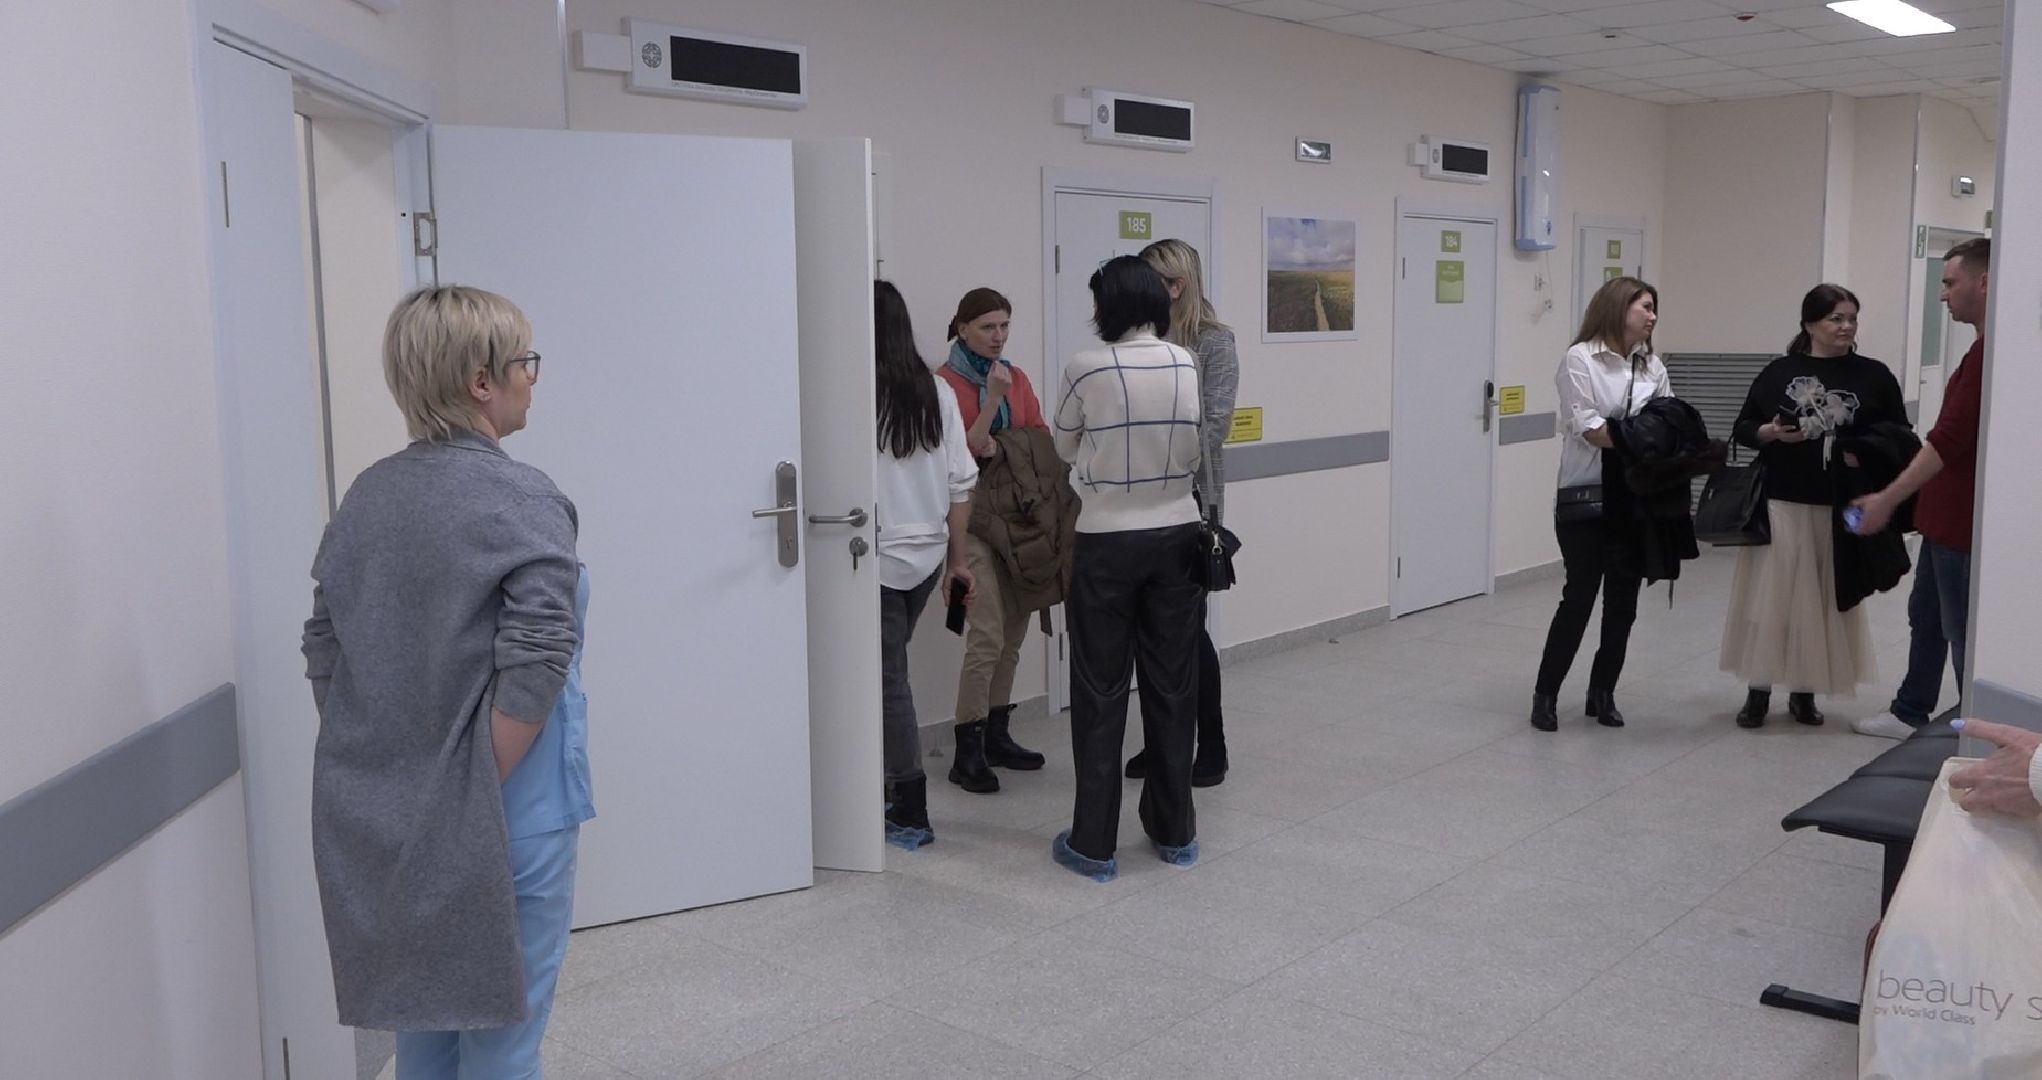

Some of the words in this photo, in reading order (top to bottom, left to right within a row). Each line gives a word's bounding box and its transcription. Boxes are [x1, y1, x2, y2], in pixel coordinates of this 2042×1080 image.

[1127, 216, 1147, 233] 185
[1877, 968, 2014, 1021] beauty
[1893, 1004, 1936, 1020] World
[1940, 1008, 1976, 1026] Class
